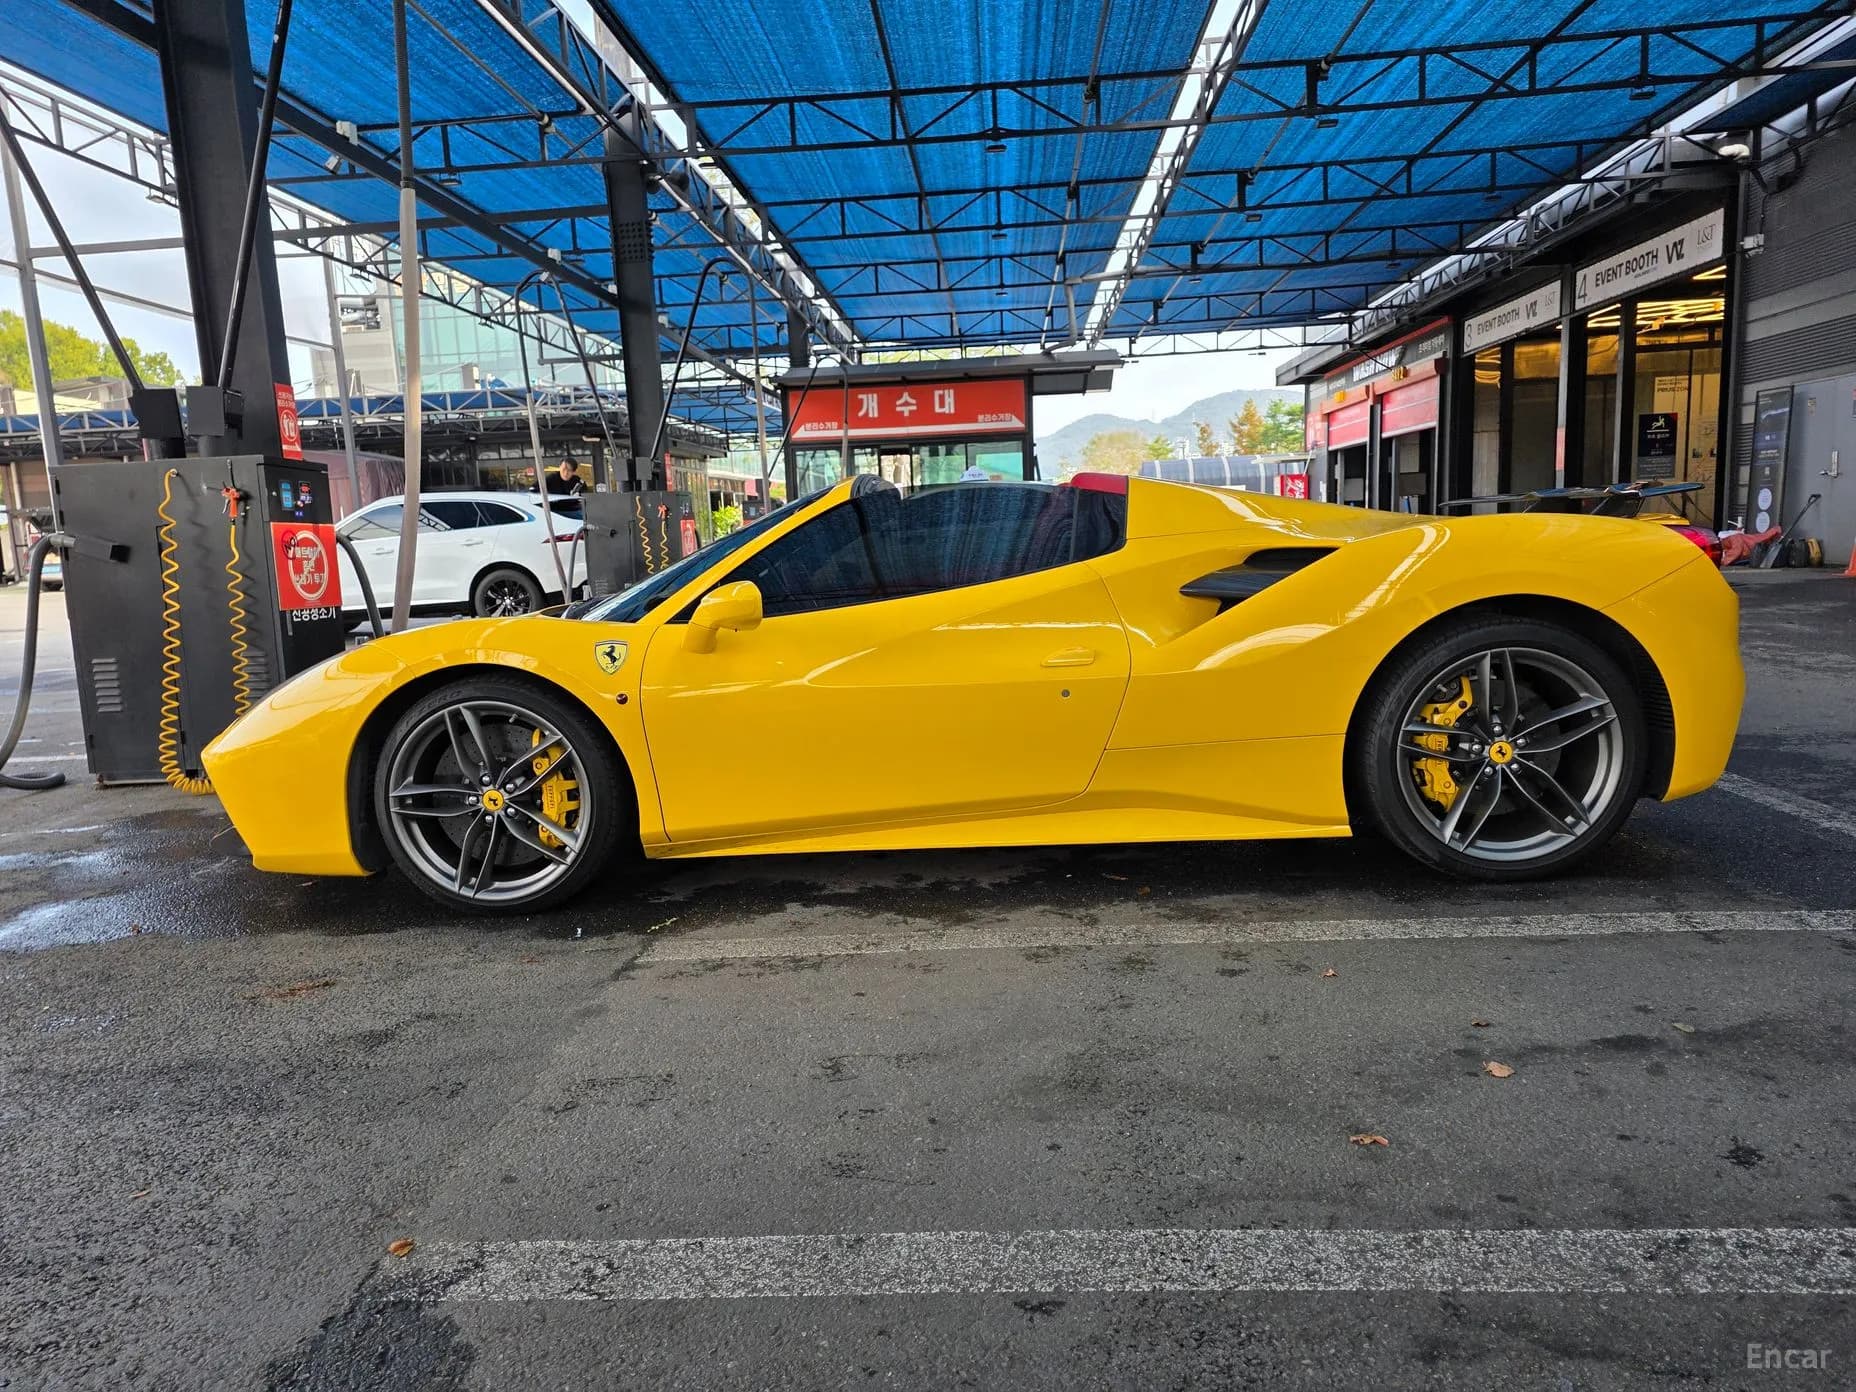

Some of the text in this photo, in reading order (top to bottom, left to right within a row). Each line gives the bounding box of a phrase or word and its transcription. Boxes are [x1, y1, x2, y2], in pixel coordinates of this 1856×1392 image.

[1577, 273, 1588, 304] 4
[1595, 263, 1624, 288] EVENT
[1625, 248, 1659, 277] BOOTH
[1465, 323, 1472, 348] 3
[1477, 316, 1497, 336] EVENT
[1497, 307, 1520, 328] BOOTH
